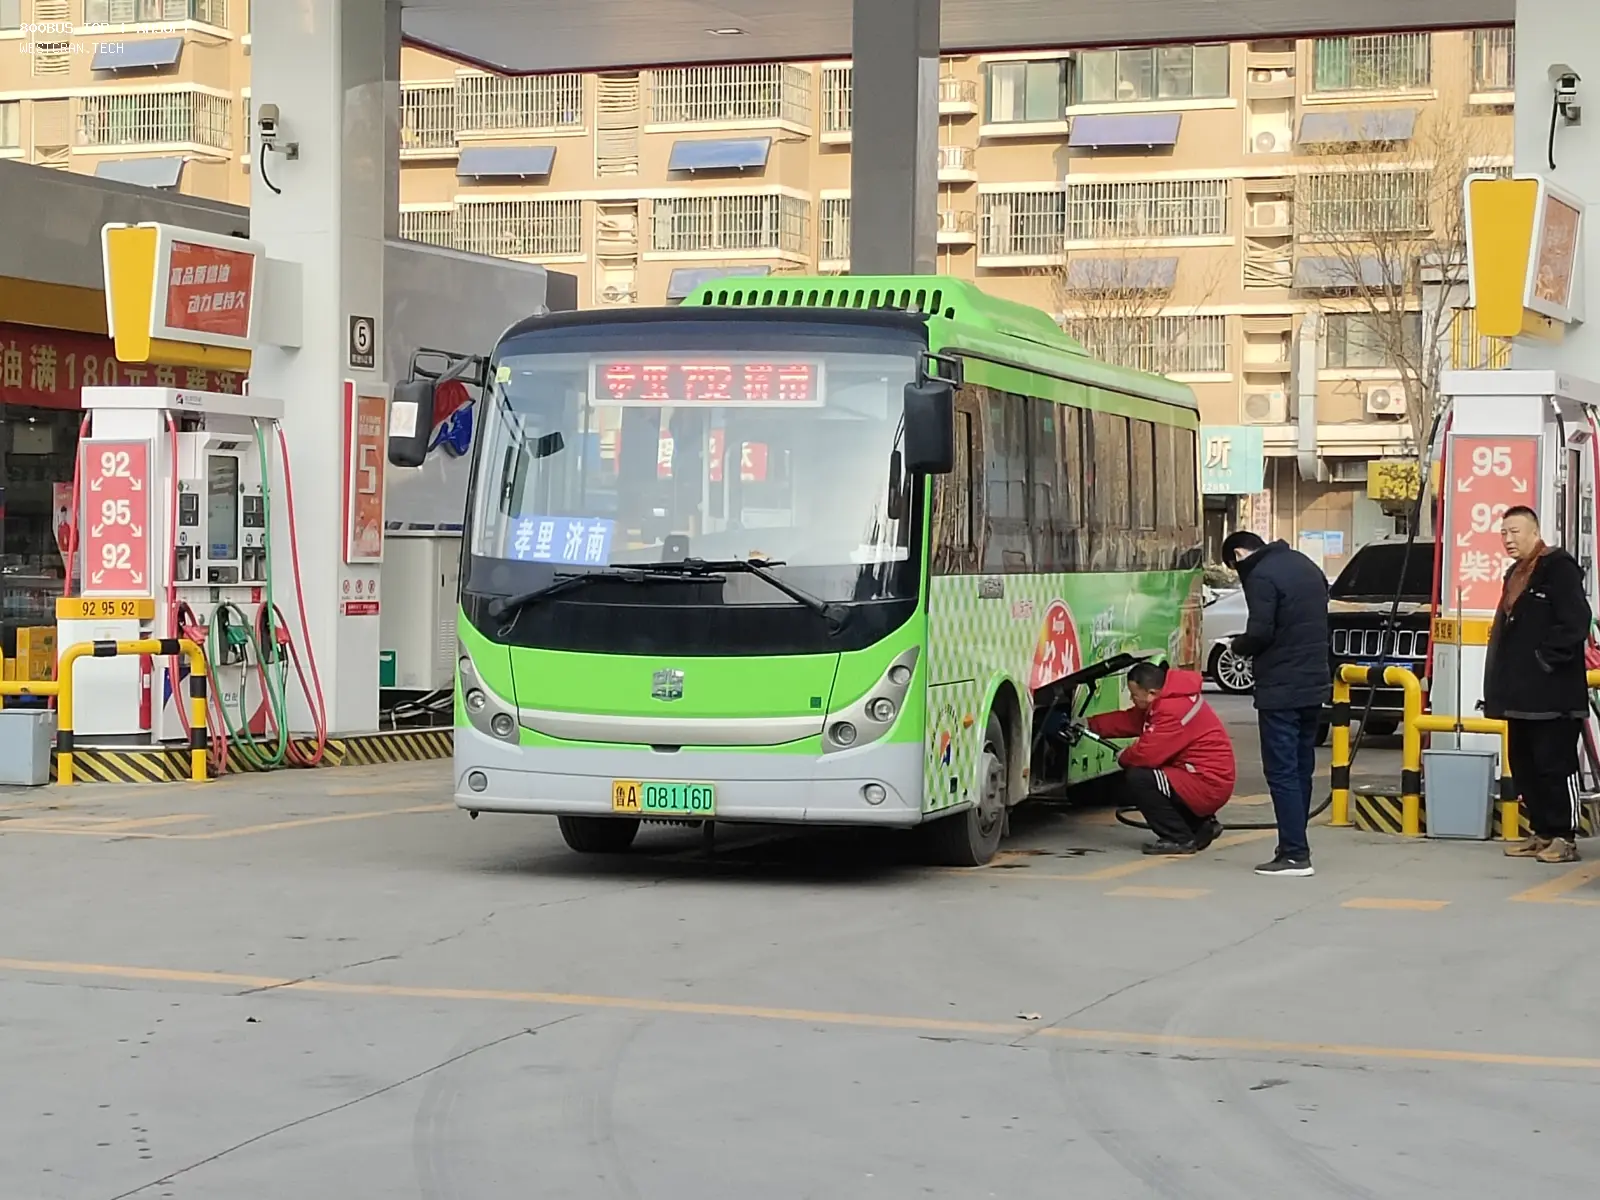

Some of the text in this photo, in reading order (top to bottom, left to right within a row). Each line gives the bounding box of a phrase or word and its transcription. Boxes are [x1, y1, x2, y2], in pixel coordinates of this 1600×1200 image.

[359, 326, 367, 347] 5
[101, 451, 131, 477] 92
[1204, 437, 1231, 469] 所
[1472, 446, 1512, 476] 95
[102, 499, 131, 525] 95
[514, 518, 607, 562] 孝里 济南
[102, 543, 131, 569] 92
[82, 601, 135, 616] 92 95 92
